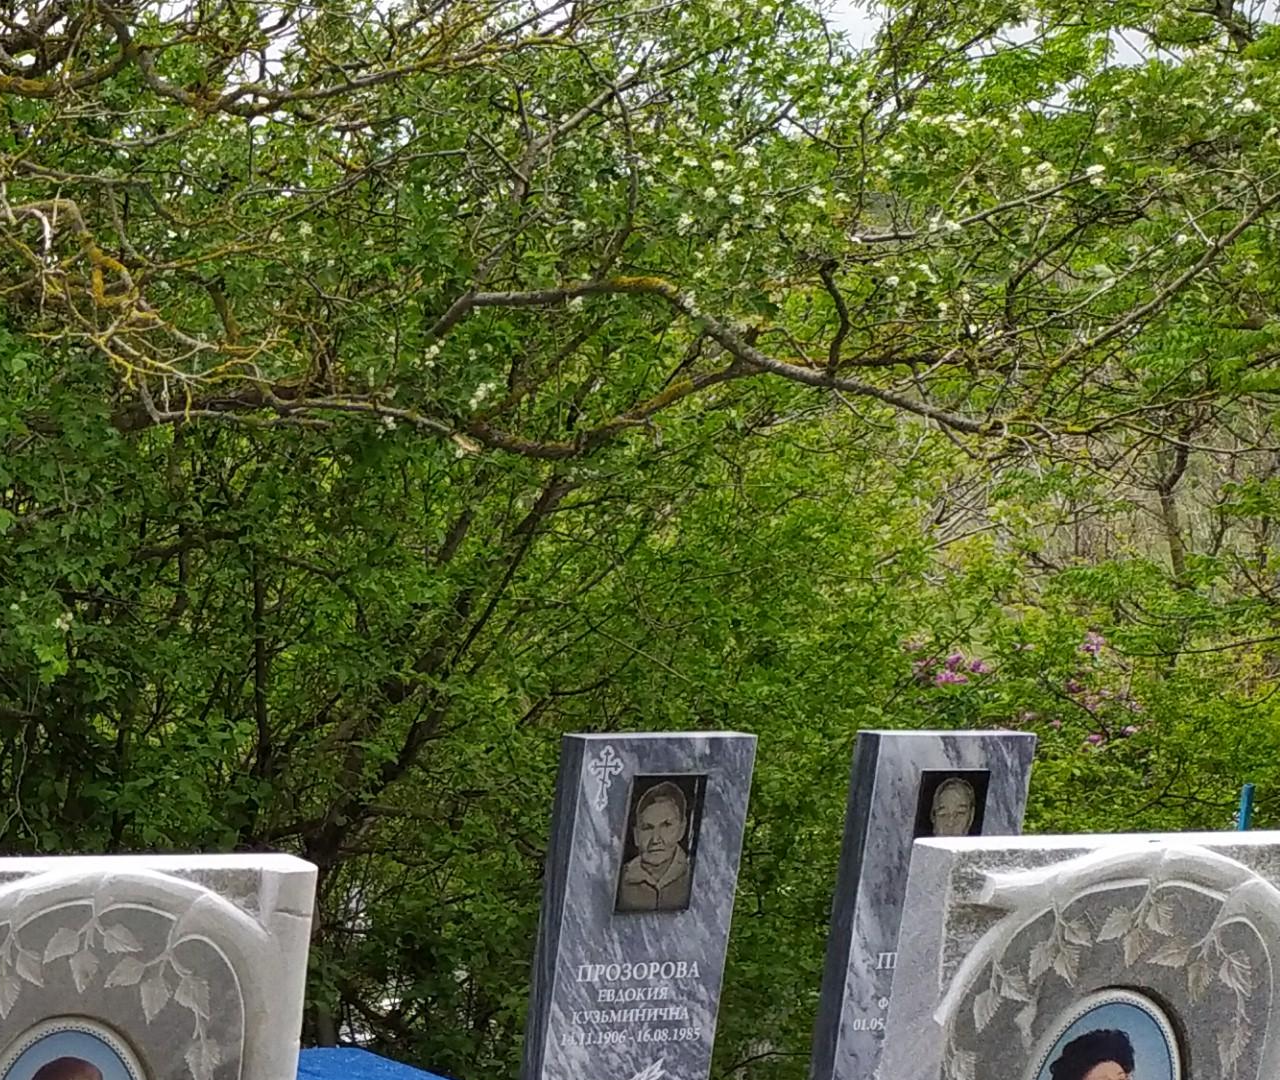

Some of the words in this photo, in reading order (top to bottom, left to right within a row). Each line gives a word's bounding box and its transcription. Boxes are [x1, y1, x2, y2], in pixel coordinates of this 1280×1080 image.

[576, 961, 700, 982] ПРОЗОРОВА
[597, 986, 669, 1003] ЕВДОКИЯ
[571, 1006, 690, 1025] КУЗЬМИНИЧНА
[636, 1027, 701, 1043] 16.08.1985
